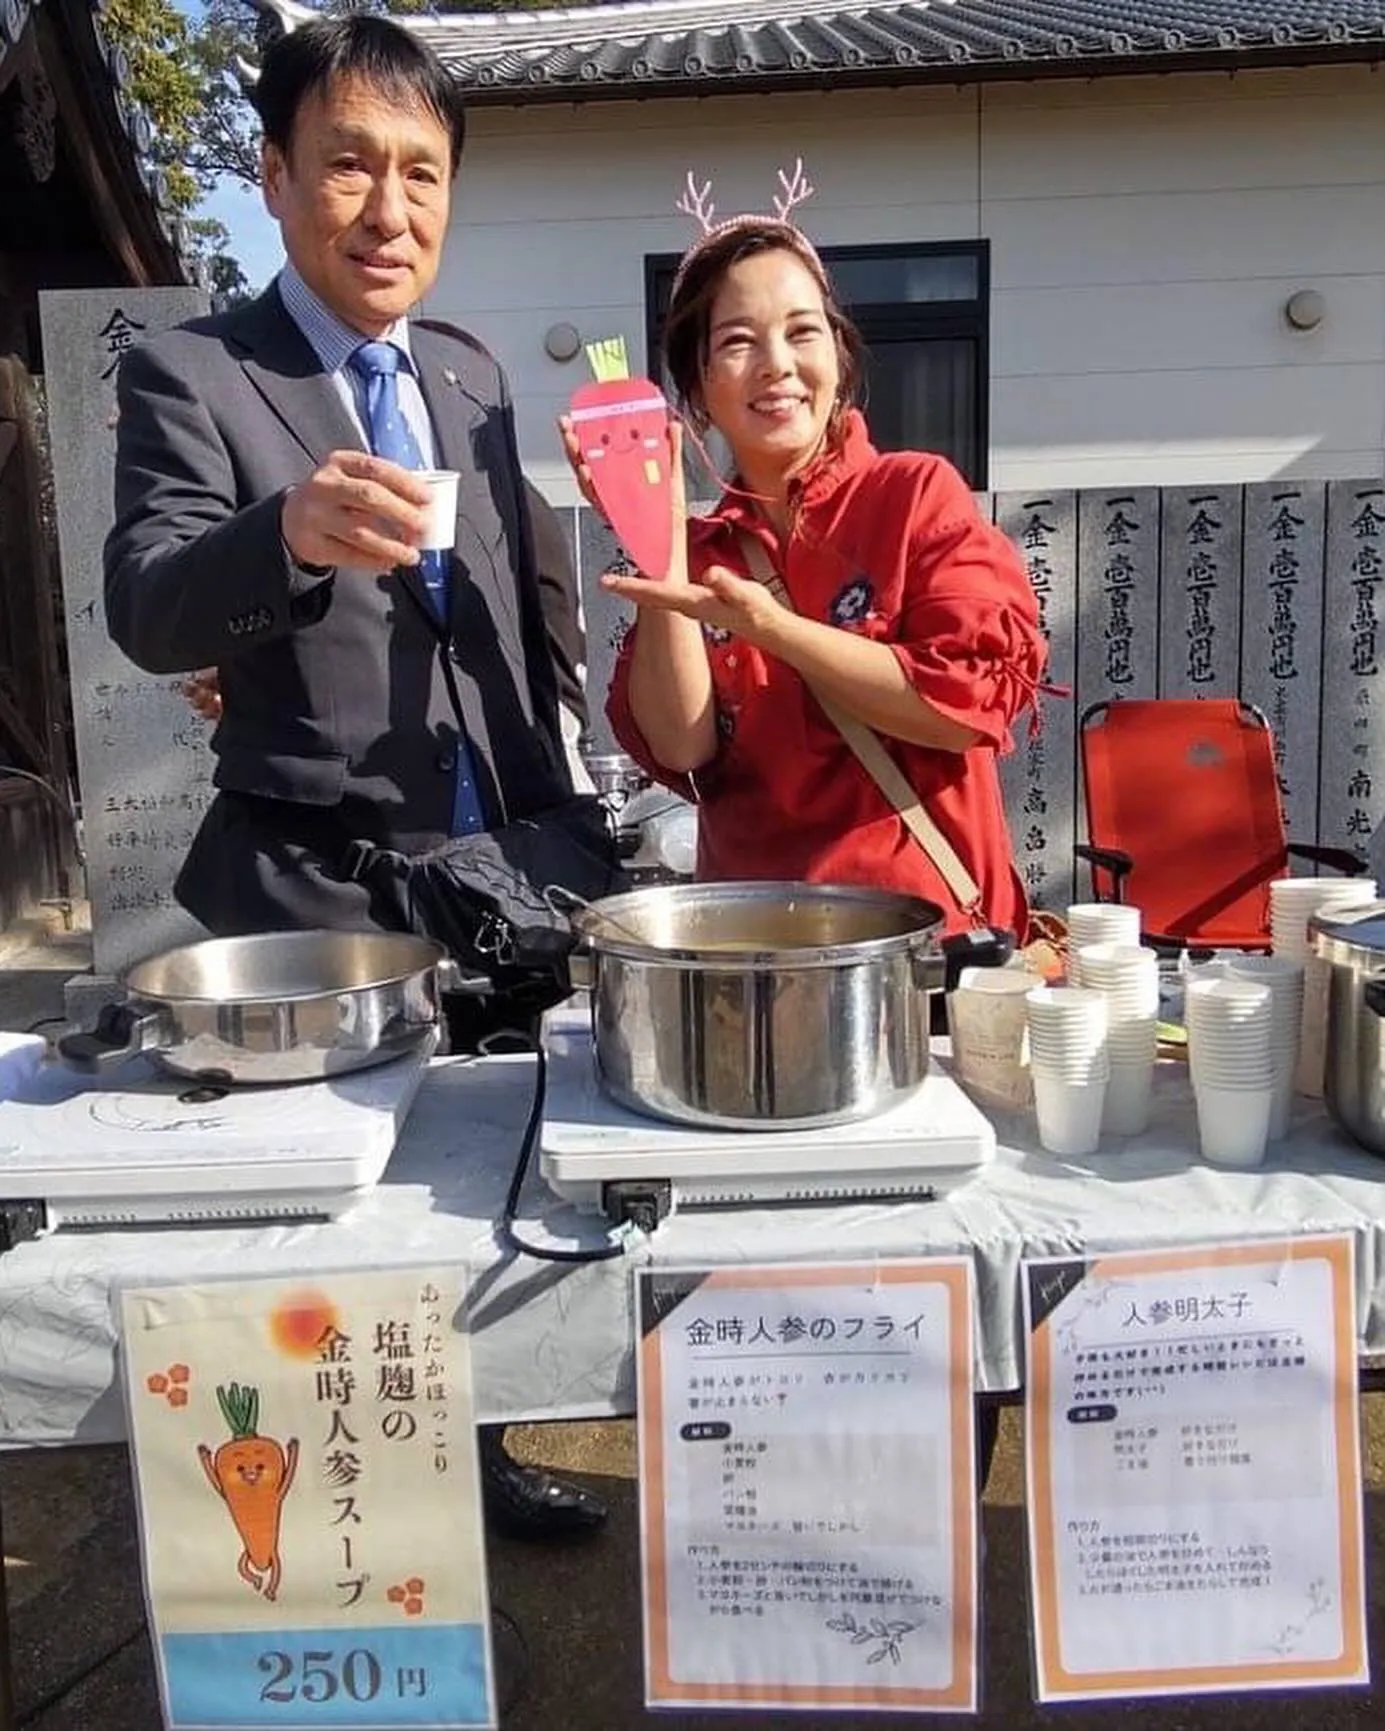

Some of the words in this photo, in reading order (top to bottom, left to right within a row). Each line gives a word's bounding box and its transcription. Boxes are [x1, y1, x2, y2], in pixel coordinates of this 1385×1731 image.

[686, 1314, 925, 1346] 金時人参のフライ
[1122, 1292, 1254, 1327] 人参明太子
[420, 1283, 448, 1475] あったかほっこり
[315, 1325, 371, 1609] 金時人参スープ
[257, 1649, 381, 1703] 250
[398, 1669, 428, 1698] 円
